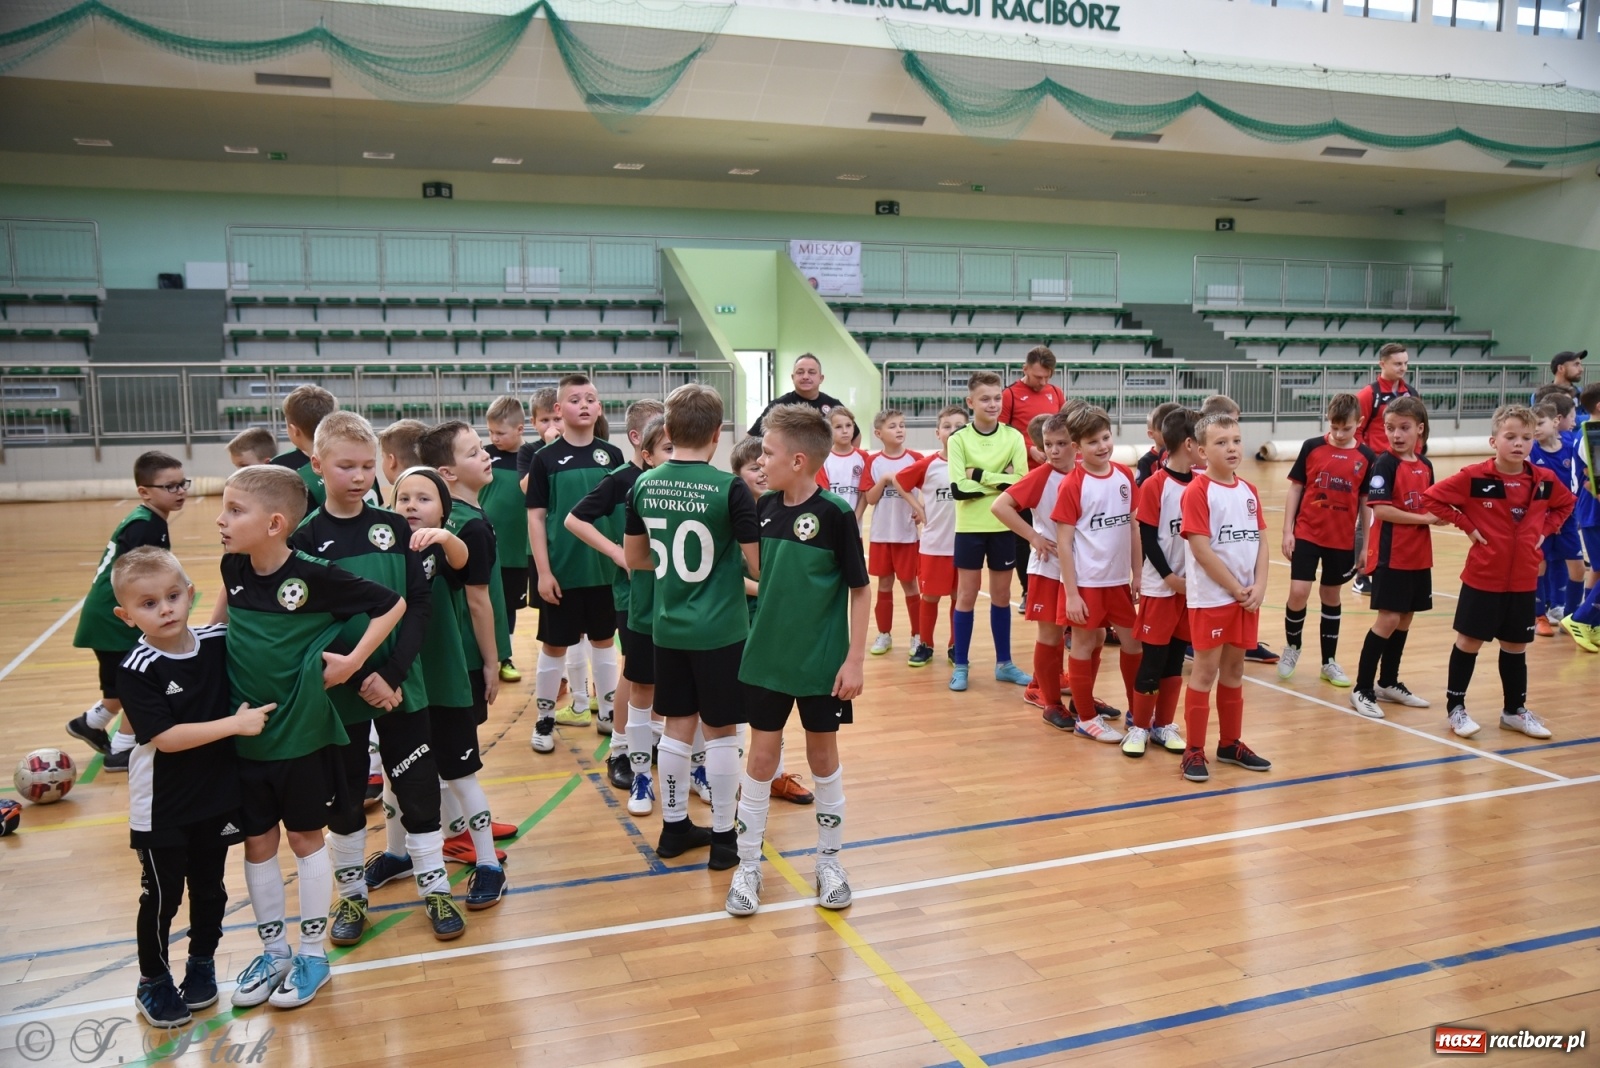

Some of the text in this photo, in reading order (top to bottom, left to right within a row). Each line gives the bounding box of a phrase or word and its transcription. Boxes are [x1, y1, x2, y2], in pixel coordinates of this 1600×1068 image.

[991, 0, 1121, 31] RACIBÓRZ
[426, 187, 435, 196] B
[878, 205, 889, 214] C
[1218, 222, 1230, 230] D
[798, 243, 853, 256] MIESZKO
[674, 480, 719, 493] PIŁKARSKA
[683, 491, 705, 499] LKS-u
[643, 498, 709, 514] TWORKÓW
[642, 516, 715, 583] 50
[165, 687, 184, 695] adidas
[220, 828, 240, 836] adidas
